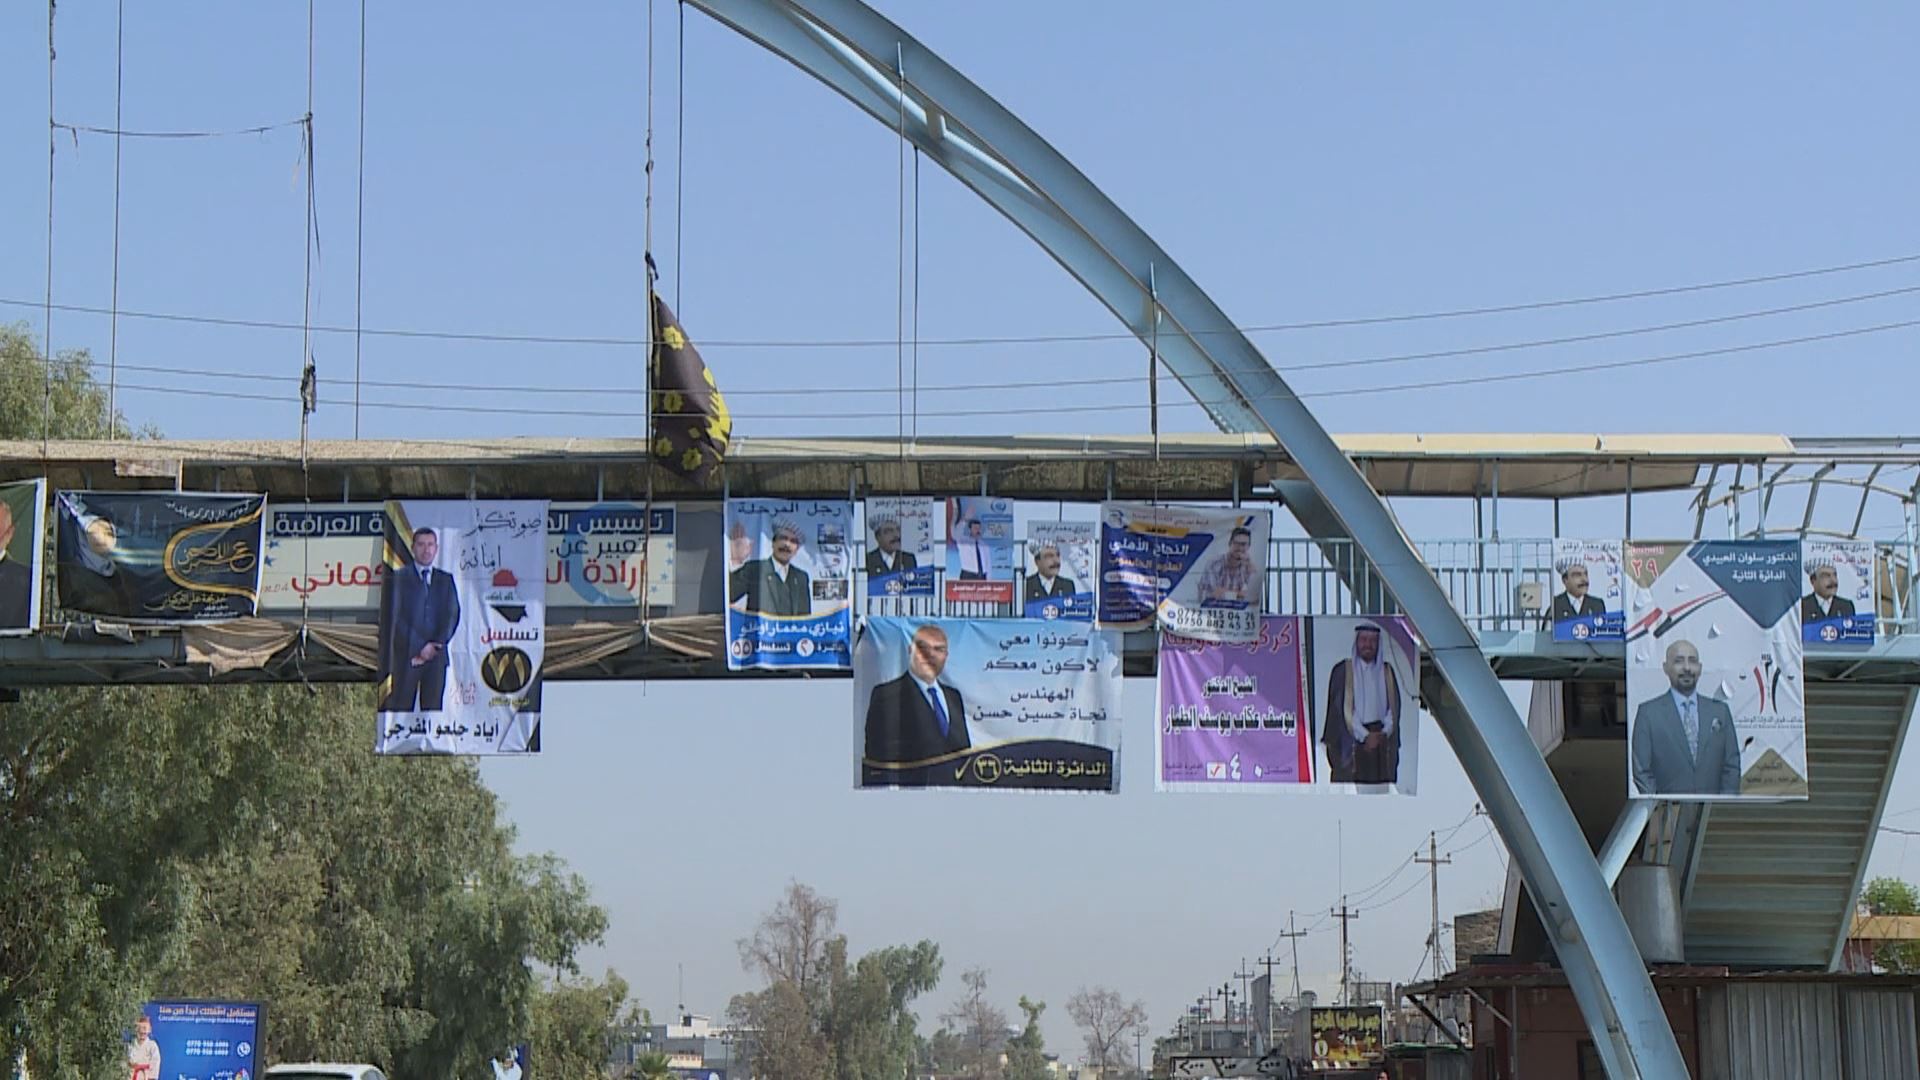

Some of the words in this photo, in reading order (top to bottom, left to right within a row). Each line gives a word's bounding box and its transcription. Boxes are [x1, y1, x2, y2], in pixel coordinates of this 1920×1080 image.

[738, 502, 798, 517] المرحلة
[807, 504, 841, 516] رجل
[275, 513, 360, 538] العراقية
[597, 537, 646, 559] تعبير
[1109, 538, 1149, 555] الأهلي
[1153, 543, 1189, 557] النجاح
[1702, 552, 1736, 567] العبيدي
[1738, 552, 1764, 565] سلوان
[1766, 552, 1797, 564] الدكتور
[1732, 569, 1757, 583] الثانية
[1759, 569, 1786, 583] الدائرة
[481, 627, 539, 644] تسلسل
[809, 621, 844, 637] نيازي
[755, 641, 791, 653] تسلسل
[999, 635, 1031, 651] معي
[1037, 632, 1089, 646] كونوا
[488, 652, 526, 688] ٧١
[984, 656, 1037, 673] معكم
[1233, 676, 1257, 697] الشيخ
[1010, 689, 1074, 703] المهندس
[973, 706, 1012, 721] حسن
[1018, 709, 1064, 722] حسين
[1070, 709, 1106, 725] نجاة
[1198, 704, 1231, 737] يوسف
[1263, 705, 1296, 737] يوسف
[976, 758, 998, 778] ٣٦
[1003, 758, 1052, 779] الثانية
[1056, 758, 1106, 777] الدائرة
